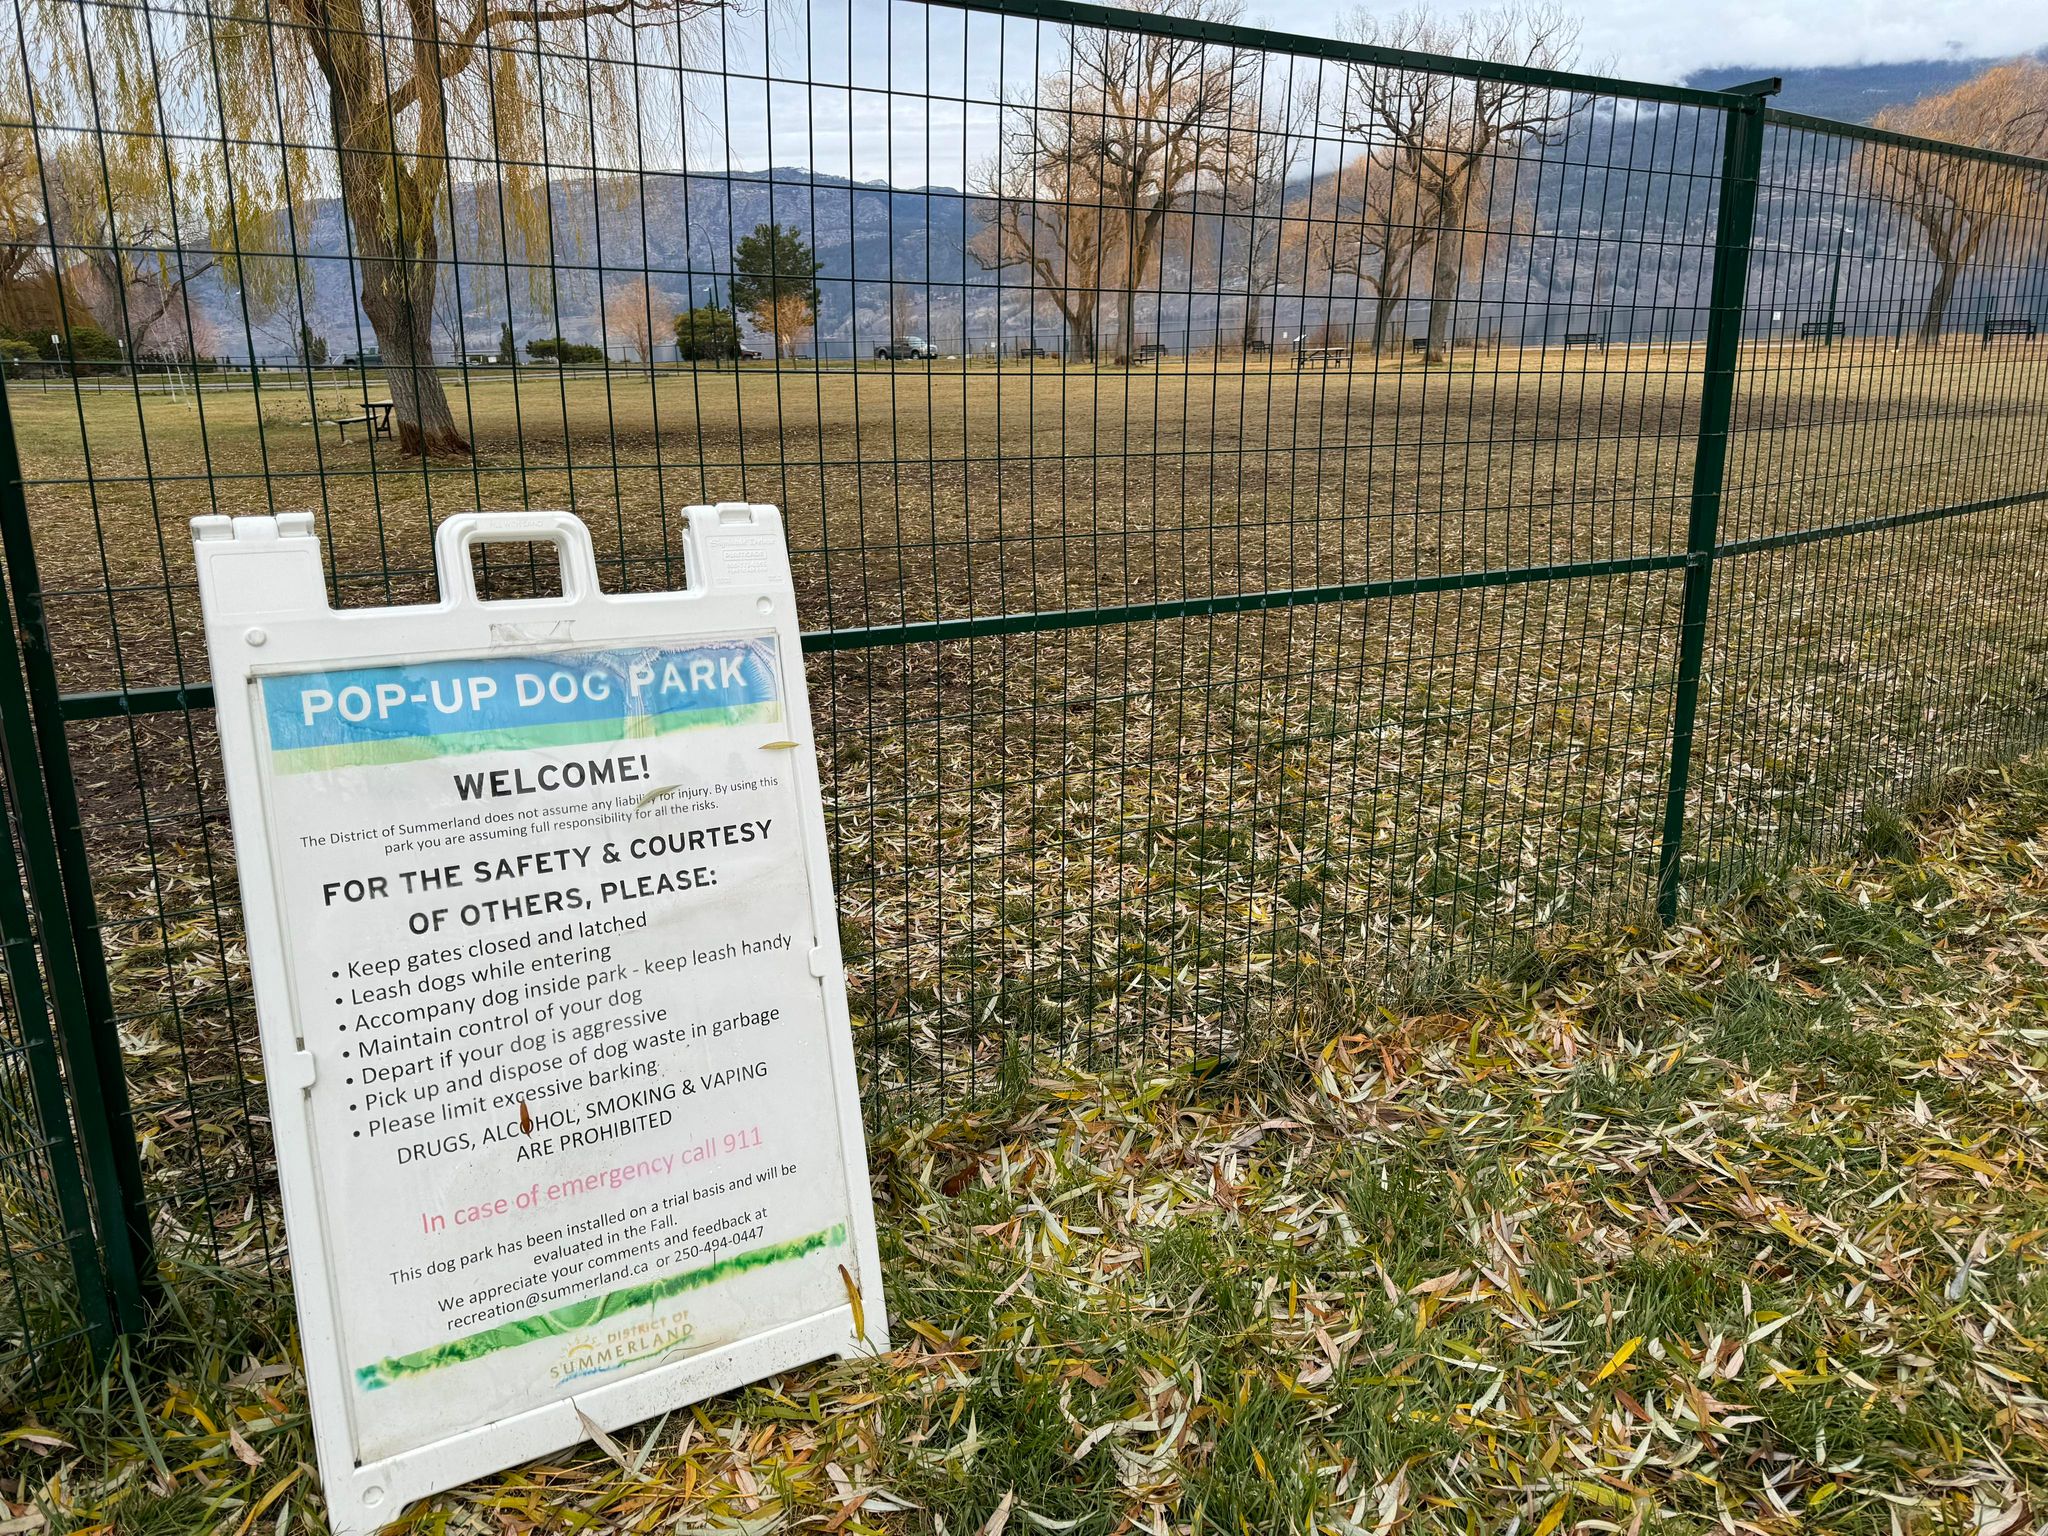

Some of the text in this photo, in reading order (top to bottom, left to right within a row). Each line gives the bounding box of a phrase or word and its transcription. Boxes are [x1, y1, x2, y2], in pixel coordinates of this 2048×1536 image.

[301, 655, 748, 726] POP-UP DOG PARK
[299, 835, 326, 848] The
[330, 828, 379, 845] District
[381, 824, 395, 838] of
[398, 813, 481, 836] Summerland
[484, 812, 515, 824] does
[517, 808, 539, 820] not
[542, 803, 588, 817] assume
[591, 800, 613, 811] any
[678, 787, 712, 801] injury.
[714, 783, 728, 795] By
[730, 780, 758, 792] using
[759, 776, 779, 787] this
[453, 754, 650, 802] WELCOME!
[322, 818, 773, 907] FOR THE SAFETY & COURTESY
[384, 799, 719, 857] park you are assuming full responsibility for all the risks.
[408, 866, 718, 936] OF OTHERS, PLEASE:
[347, 910, 647, 979] Keep gates closed and latched
[351, 945, 612, 1006] Leash dogs while entering
[354, 997, 476, 1033] Accompany
[482, 988, 520, 1008] dog
[524, 974, 581, 1000] inside
[586, 963, 628, 991] park
[644, 956, 687, 975] keep
[692, 943, 737, 966] leash
[741, 932, 792, 956] handy
[358, 989, 643, 1059] Maintain control of your dog
[361, 1008, 667, 1085] Depart if your dog is aggressive
[365, 1008, 780, 1111] Pick up and dispose of dog waste in garbage
[368, 1060, 658, 1138] Please limit excessive barking
[397, 1061, 768, 1165] DRUGS, ALCOHOL, SMOKING & VAPING
[516, 1109, 672, 1163] ARE PROHIBITED
[421, 1125, 763, 1235] In case of emergency call 911
[388, 1164, 797, 1285] This dog park has been installed on a trial basis and will be
[437, 1207, 768, 1312] We appreciate your comments and feedback at
[533, 1213, 678, 1265] evaluated in the Fall.
[447, 1225, 764, 1331] recreation@summerland.ca or 250-494-0447
[550, 1322, 693, 1380] SUMMERLAND
[607, 1309, 690, 1344] DISTRICT OF
